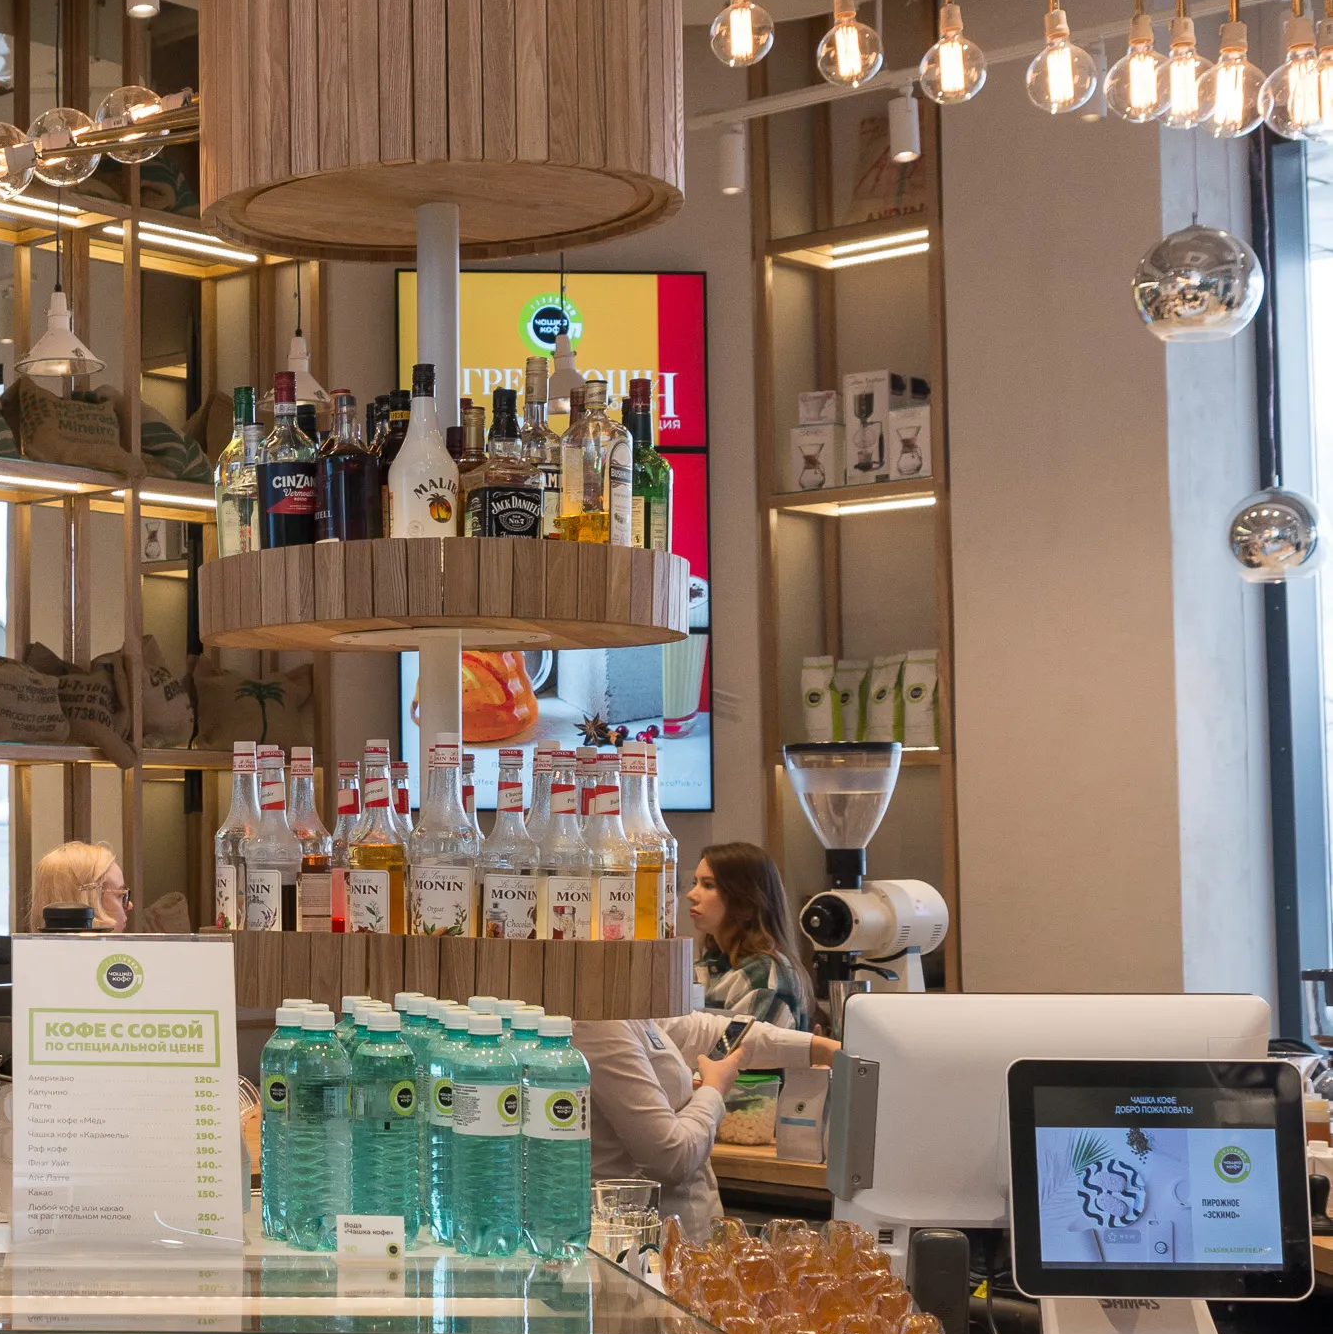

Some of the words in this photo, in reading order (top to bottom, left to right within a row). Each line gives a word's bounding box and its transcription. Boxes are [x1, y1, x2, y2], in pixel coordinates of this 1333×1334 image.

[414, 478, 459, 499] MALIB
[491, 499, 510, 515] JACK
[415, 879, 463, 892] MONIN
[45, 1022, 106, 1038] КОФЕ
[110, 1023, 124, 1038] С
[128, 1020, 203, 1039] СОБОЙ
[45, 1042, 63, 1051] ПО
[67, 1041, 166, 1053] СПЕЦИАЛЬНОЙ
[169, 1043, 204, 1054] ЦЕНЕ
[28, 1075, 75, 1085] Американо
[28, 1088, 68, 1098] Капучино
[1130, 1096, 1156, 1105] ЧАШКА
[1157, 1096, 1177, 1104] КОФЕ
[1115, 1106, 1140, 1115] ДОБРО
[1141, 1106, 1193, 1115] ПОЖАЛОВАТЬ!
[57, 1116, 78, 1126] кофе
[79, 1116, 106, 1126] «Мёд»
[27, 1131, 55, 1139] Чашка
[57, 1131, 78, 1140] кофе
[79, 1131, 129, 1140] «Карамель»
[28, 1145, 45, 1154] Раф
[47, 1145, 68, 1154] кофе
[28, 1159, 48, 1168] Флэт
[51, 1159, 70, 1169] Уайт
[28, 1173, 44, 1181] Айс
[46, 1174, 70, 1182] Латте
[27, 1203, 58, 1212] Любой
[59, 1204, 80, 1213] кофе
[1202, 1199, 1240, 1207] ПИРОЖНОЕ
[40, 1213, 99, 1221] растительном
[1203, 1211, 1240, 1219] «ЭСКИМО»
[28, 1227, 55, 1236] Сироп
